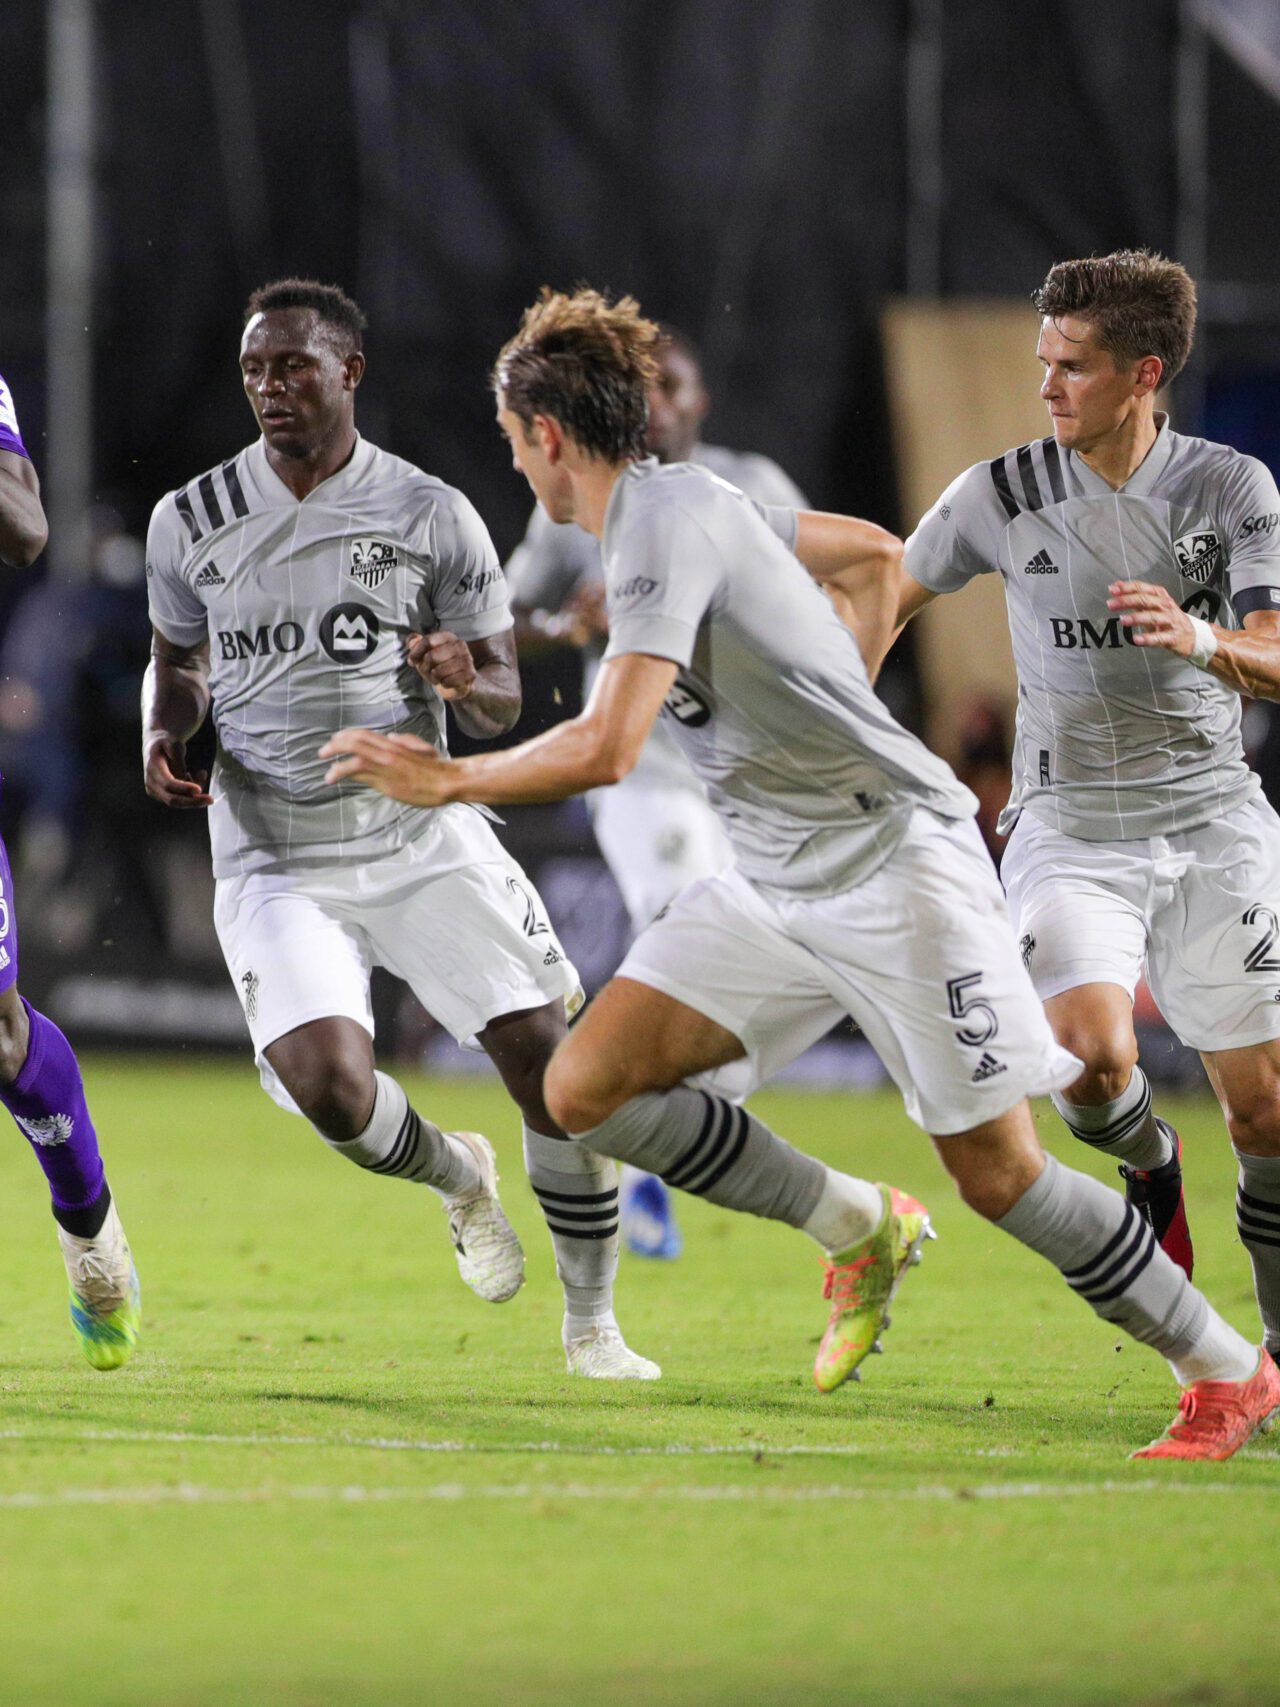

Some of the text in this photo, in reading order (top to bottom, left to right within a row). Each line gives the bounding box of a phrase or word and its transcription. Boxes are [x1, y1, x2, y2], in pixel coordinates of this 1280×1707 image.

[1240, 513, 1280, 539] Sap
[1024, 565, 1059, 575] adidas
[217, 621, 305, 660] BMO
[505, 876, 549, 937] 2
[1242, 902, 1280, 973] 2
[946, 971, 998, 1046] 5
